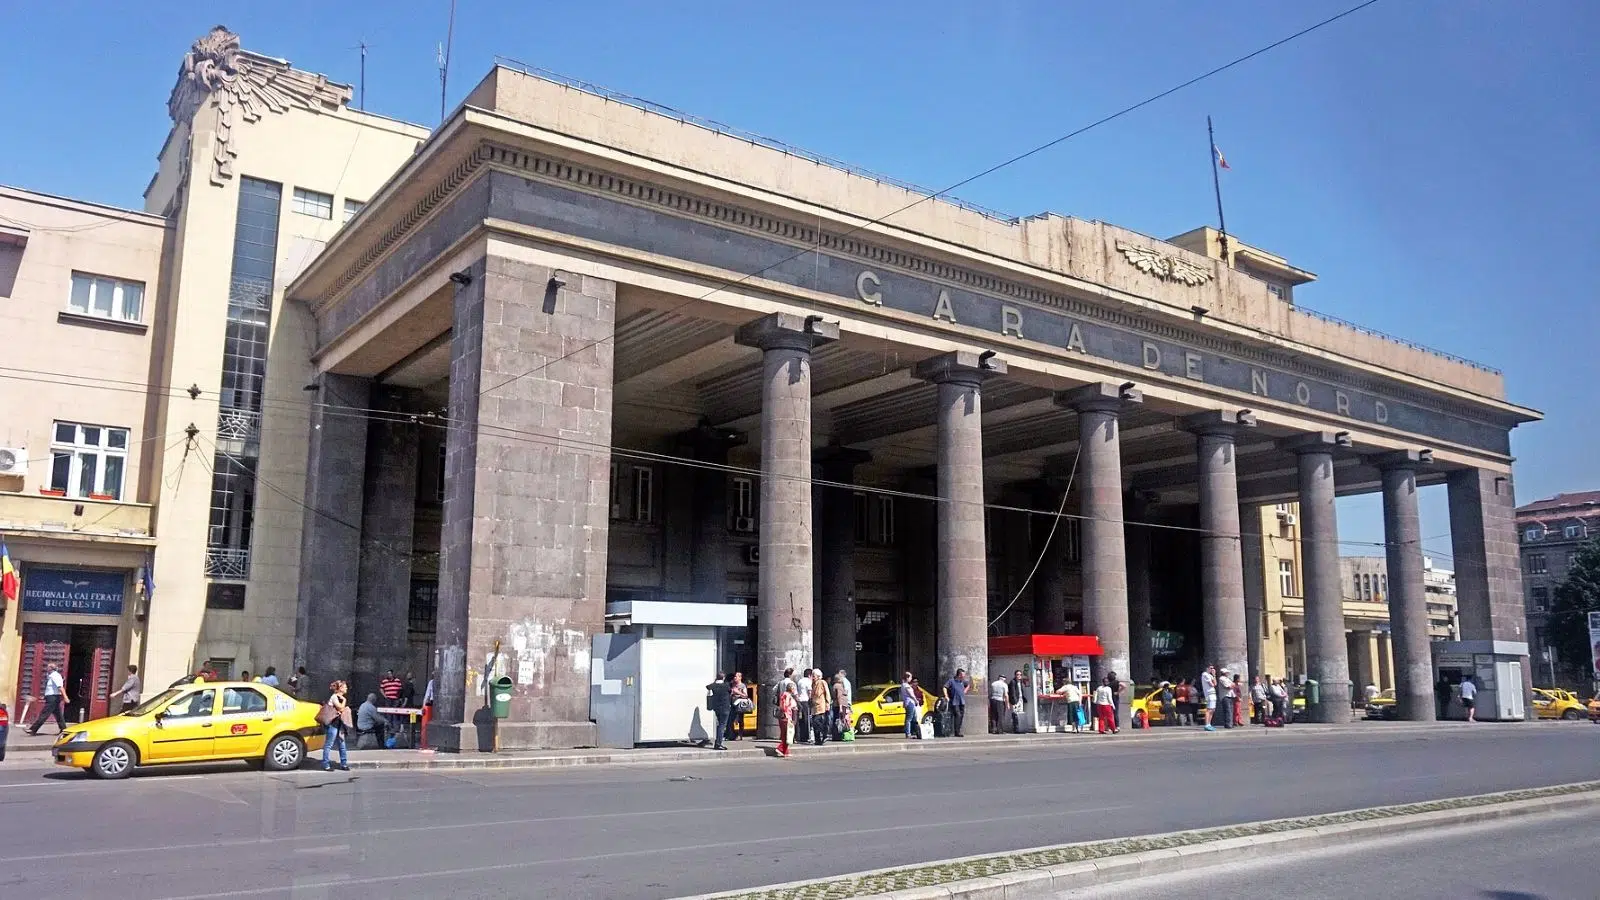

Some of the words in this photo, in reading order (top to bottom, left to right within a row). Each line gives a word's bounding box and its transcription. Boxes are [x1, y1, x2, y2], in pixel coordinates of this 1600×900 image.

[857, 270, 1086, 354] GARA
[1143, 341, 1203, 381] DE
[1251, 368, 1388, 423] NORD
[90, 592, 121, 602] FERATE
